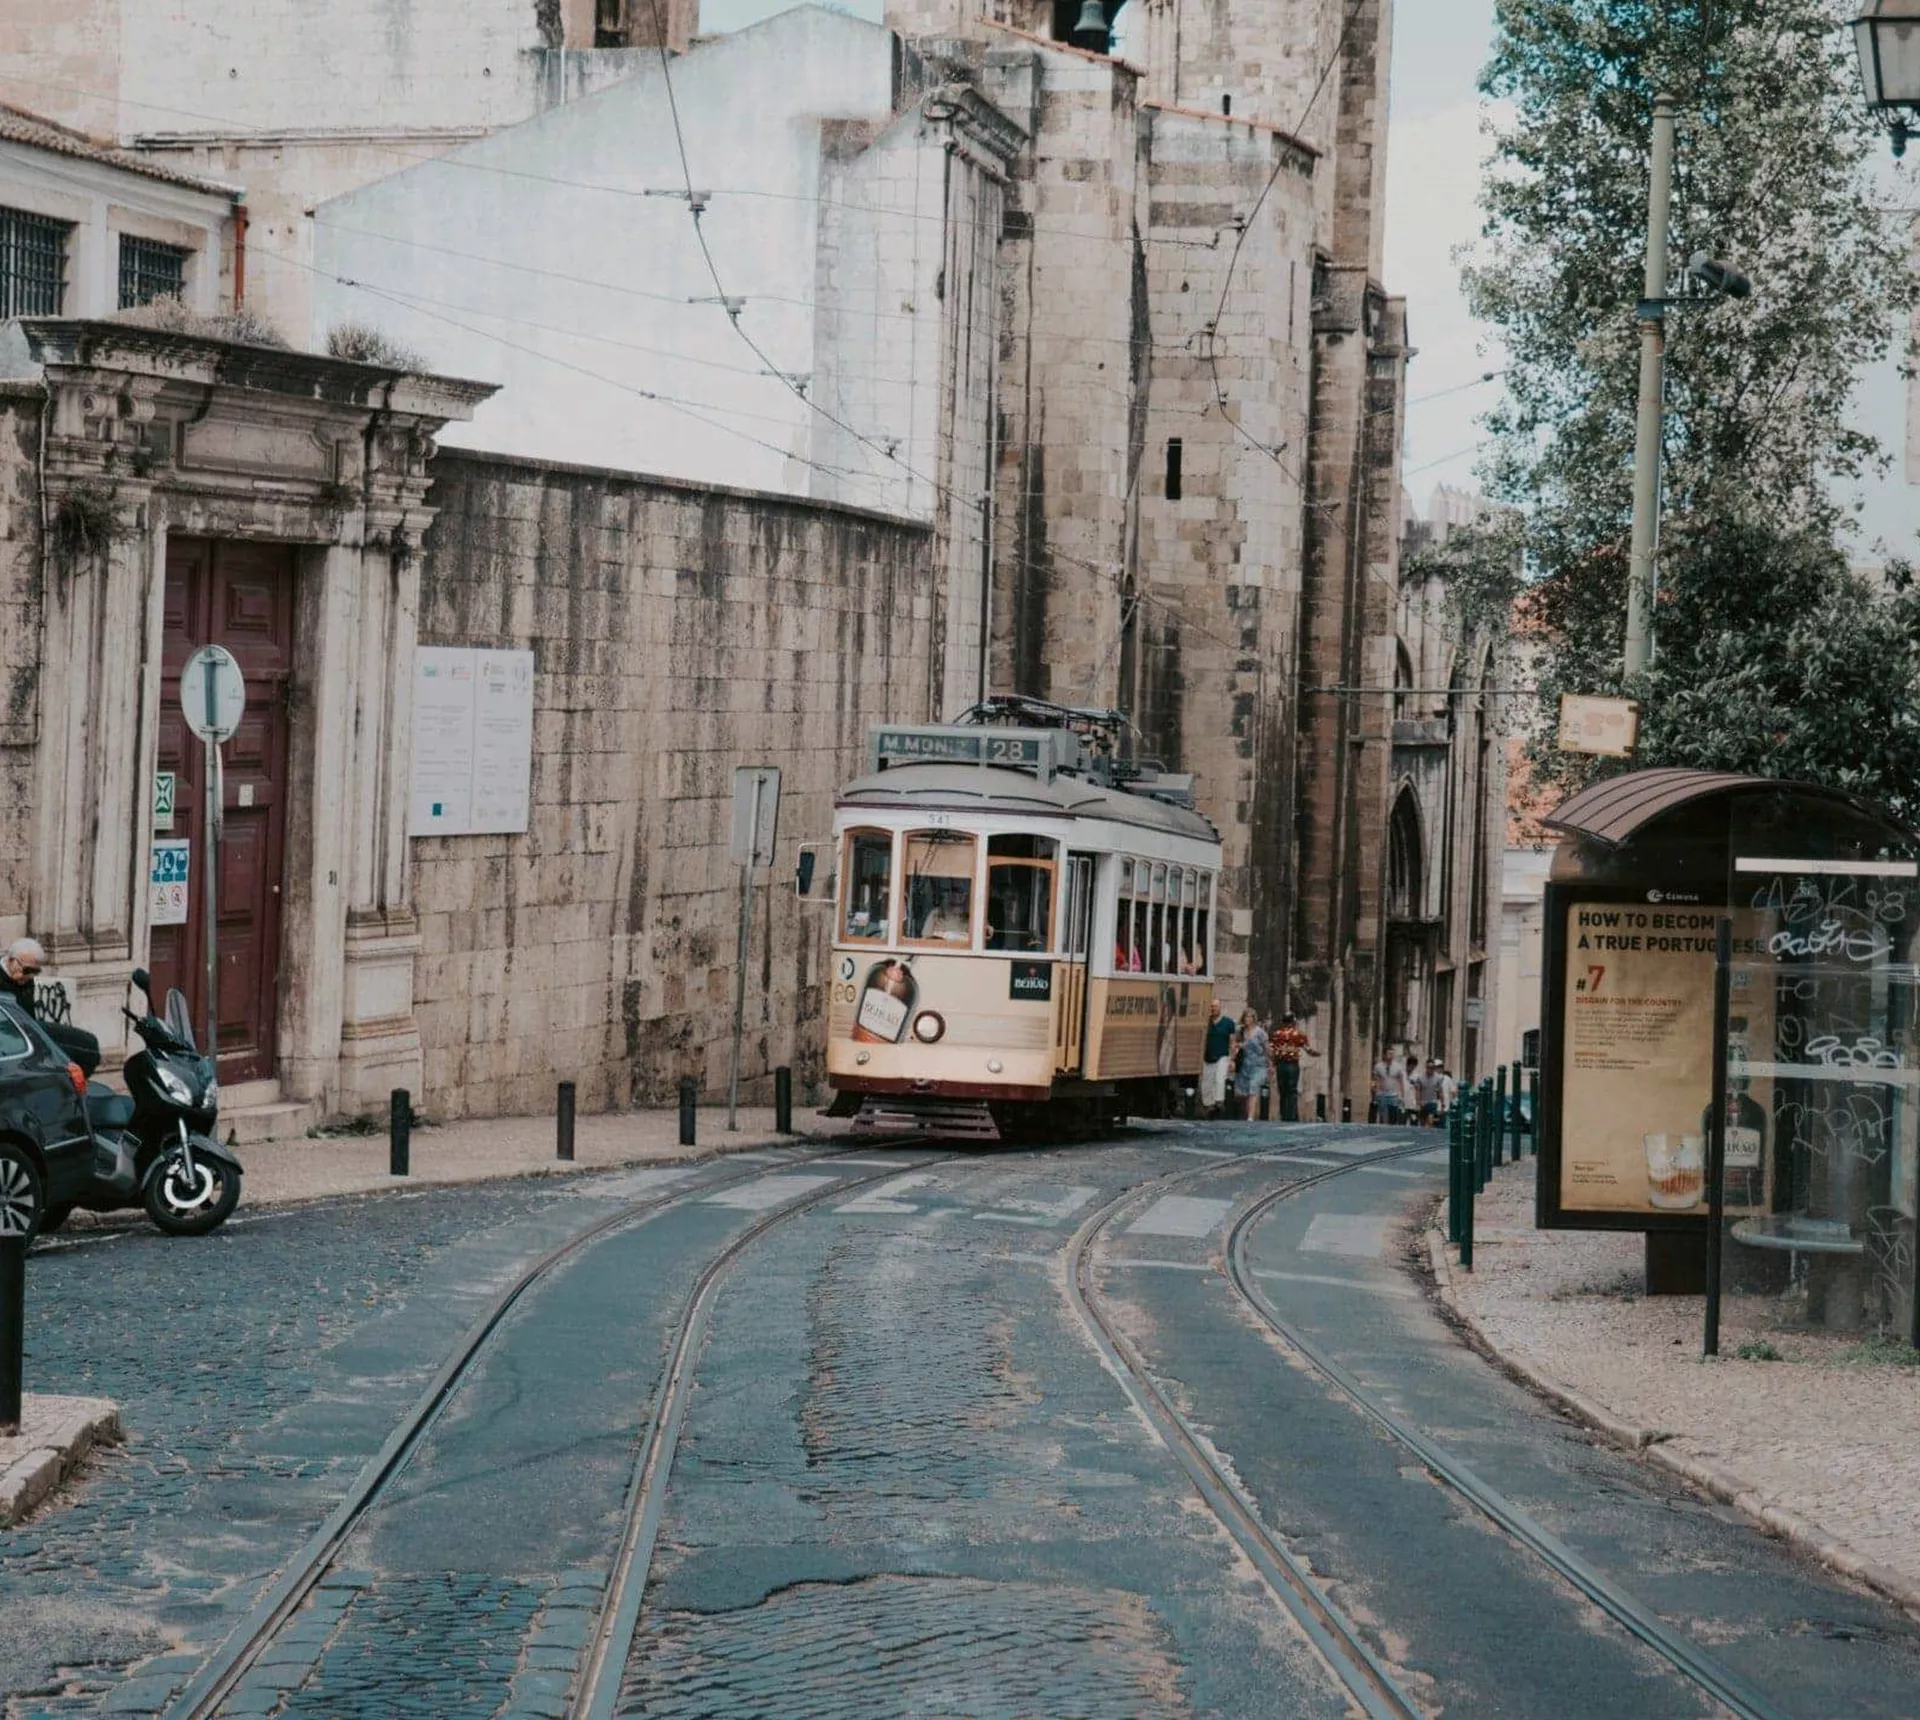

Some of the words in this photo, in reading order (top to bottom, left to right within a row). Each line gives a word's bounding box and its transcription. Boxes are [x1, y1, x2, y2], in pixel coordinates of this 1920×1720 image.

[993, 740, 1024, 761] 28
[1579, 912, 1620, 927] HOW
[1626, 914, 1647, 928] TO
[1653, 915, 1715, 930] BECOM
[1577, 935, 1590, 949] A
[1594, 936, 1640, 950] TRUE
[1646, 937, 1765, 953] PORTUGESE
